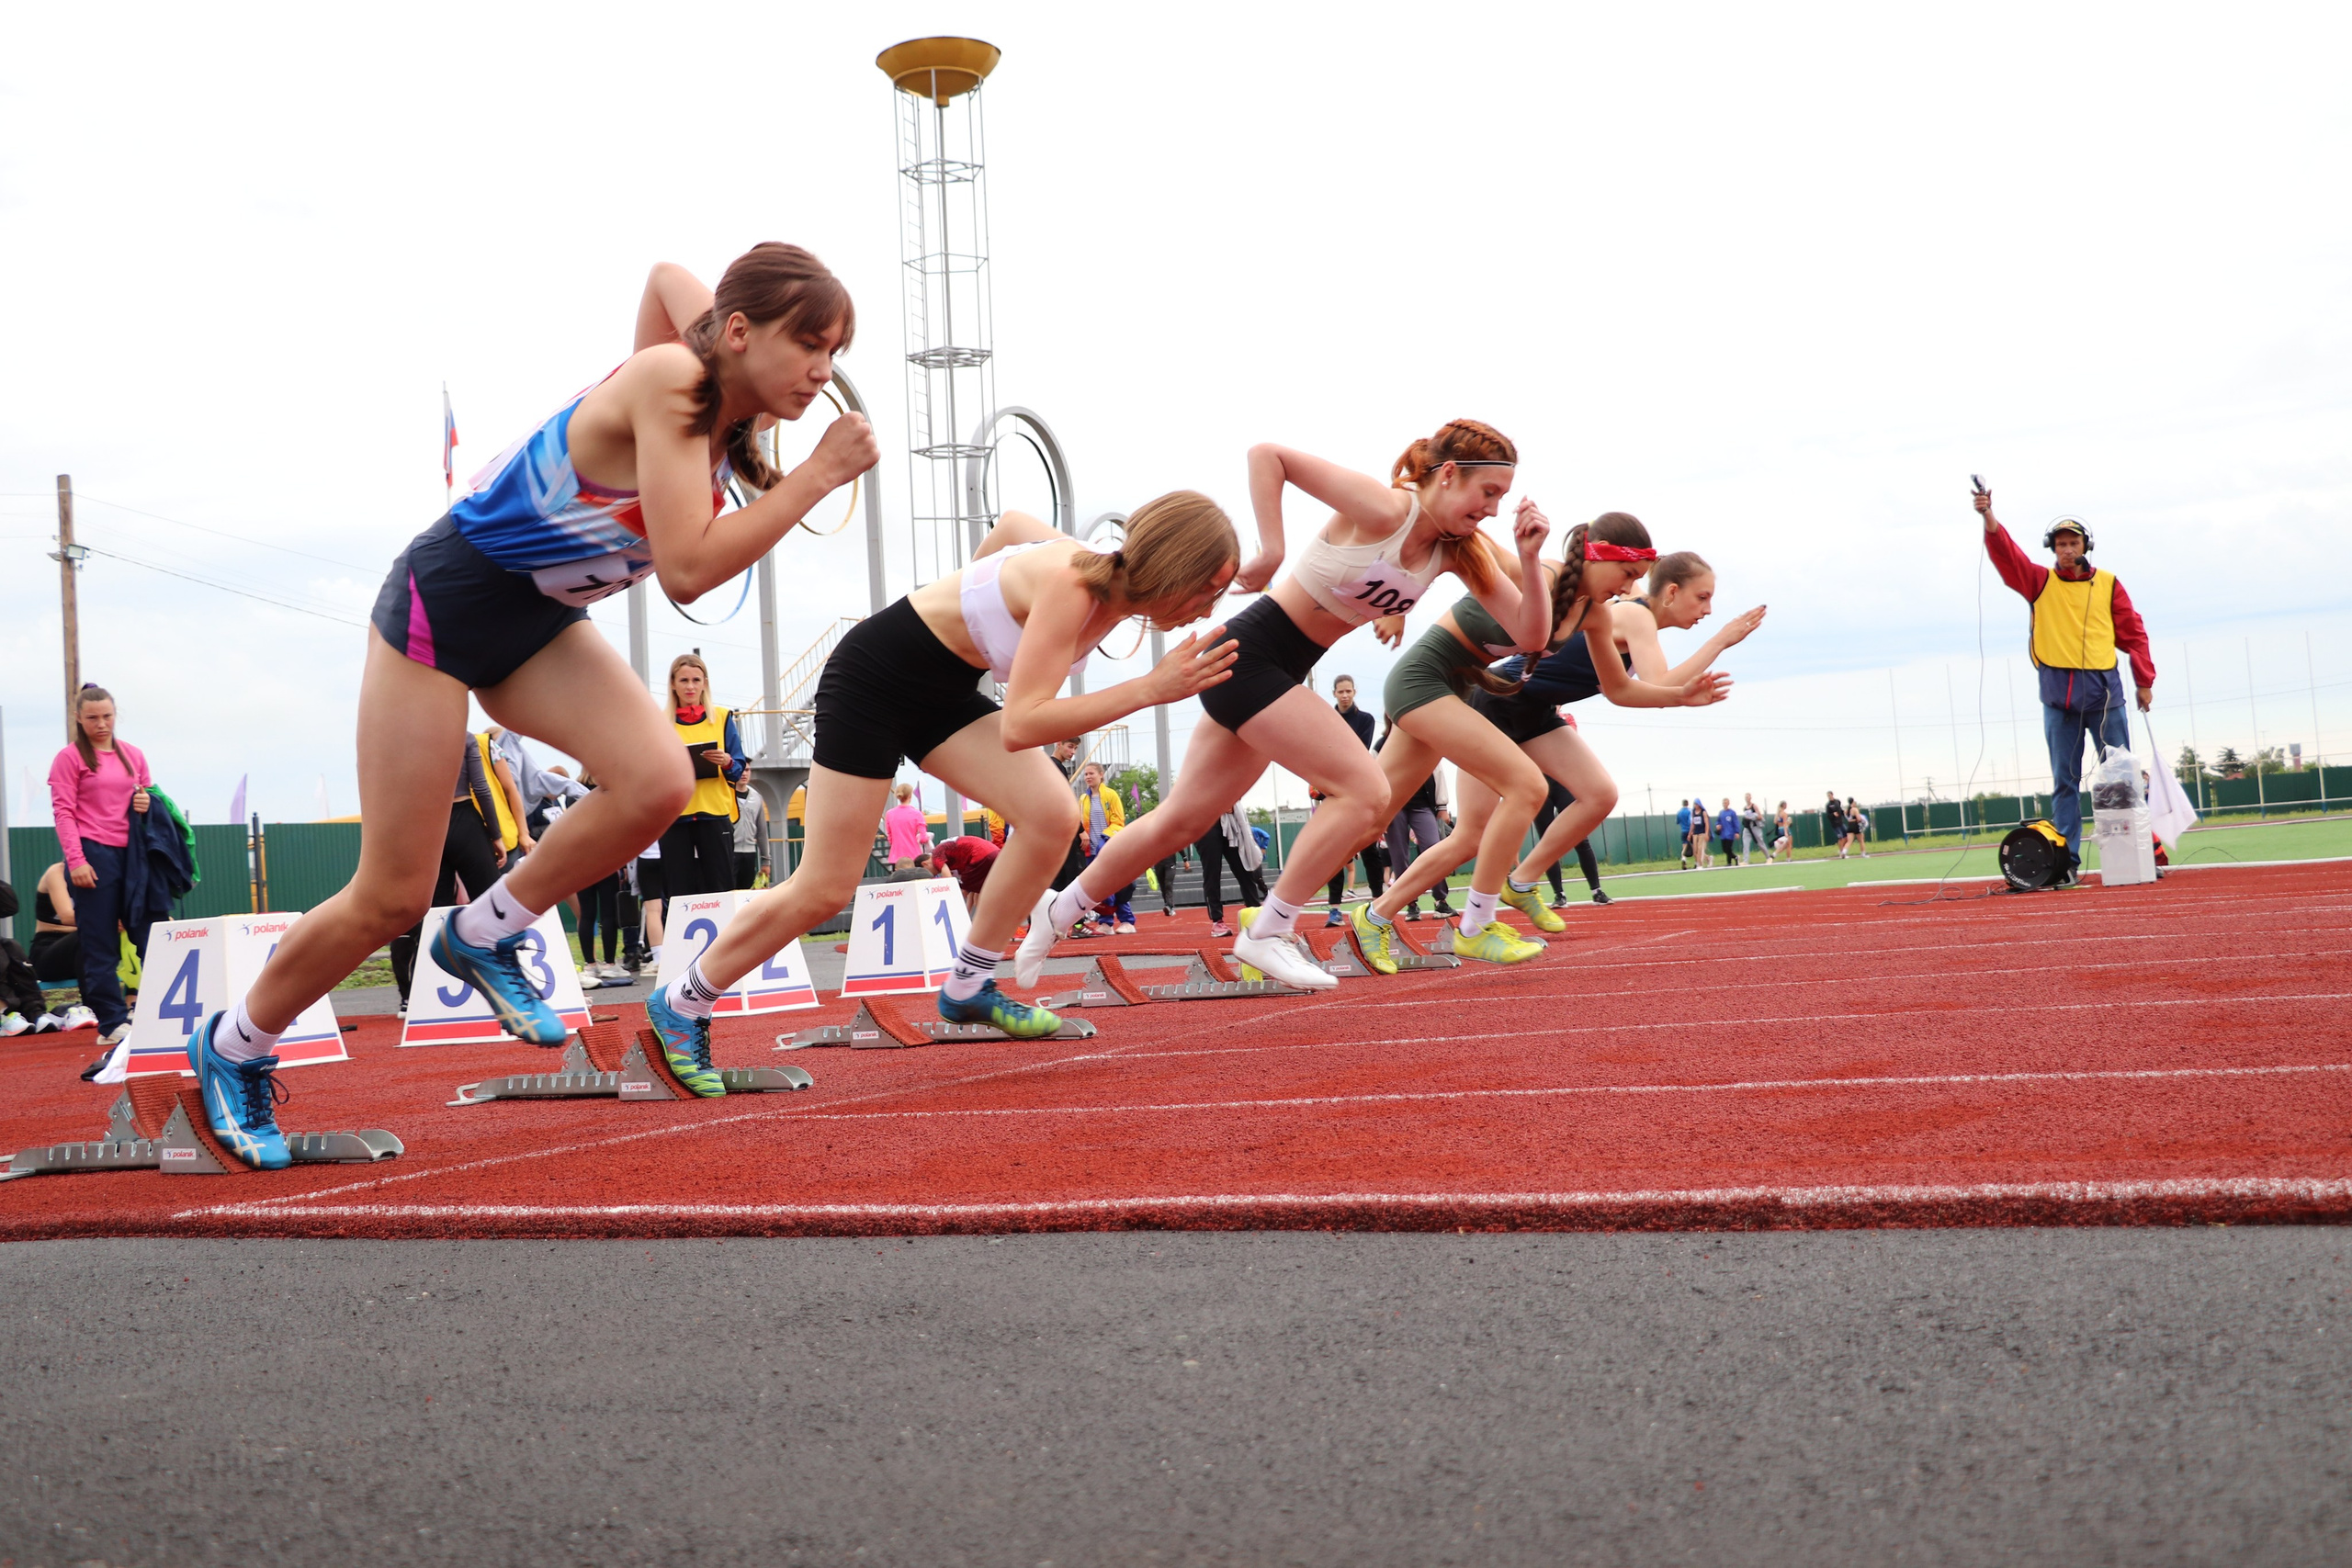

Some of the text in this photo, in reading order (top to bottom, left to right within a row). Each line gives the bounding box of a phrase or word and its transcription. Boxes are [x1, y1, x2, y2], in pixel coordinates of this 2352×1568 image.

[1354, 579, 1415, 616] 108
[876, 888, 904, 900] polanik
[931, 885, 950, 895] polanik
[690, 899, 721, 912] polanik
[174, 927, 209, 942] polanik
[253, 921, 289, 936] polanik
[872, 904, 894, 966] 1
[933, 899, 959, 959] 1
[524, 927, 556, 1001] 3
[158, 948, 204, 1035] 4
[629, 1083, 650, 1091] polanik
[172, 1148, 195, 1159] polanik
